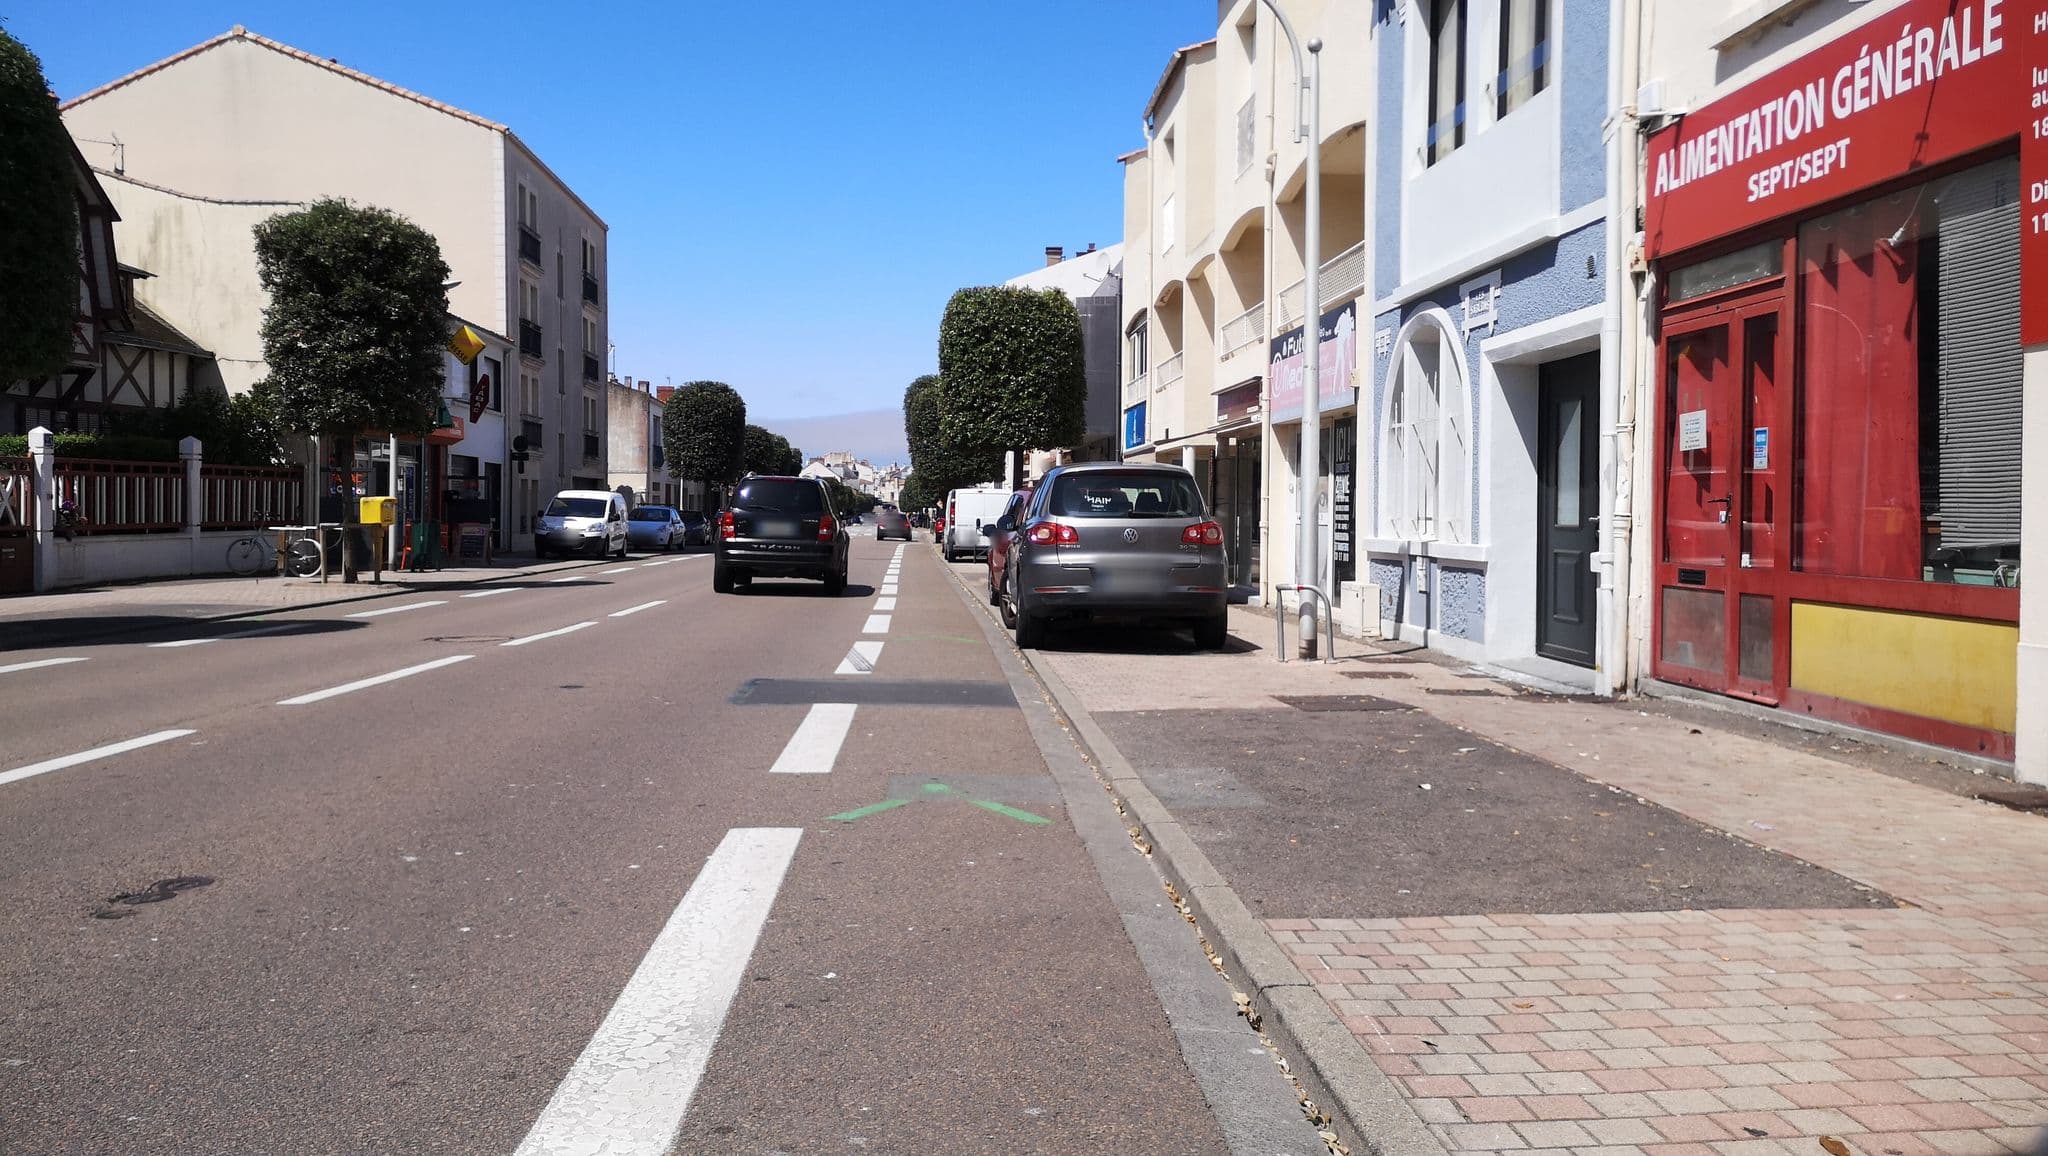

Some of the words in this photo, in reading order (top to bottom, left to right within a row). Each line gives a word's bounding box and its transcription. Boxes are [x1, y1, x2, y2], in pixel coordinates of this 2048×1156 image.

[2034, 10, 2048, 35] H
[1654, 78, 1825, 197] ALIMENTATION
[1832, 0, 2003, 120] GÉNÉRALE
[1747, 138, 1851, 202] SEPT/SEPT
